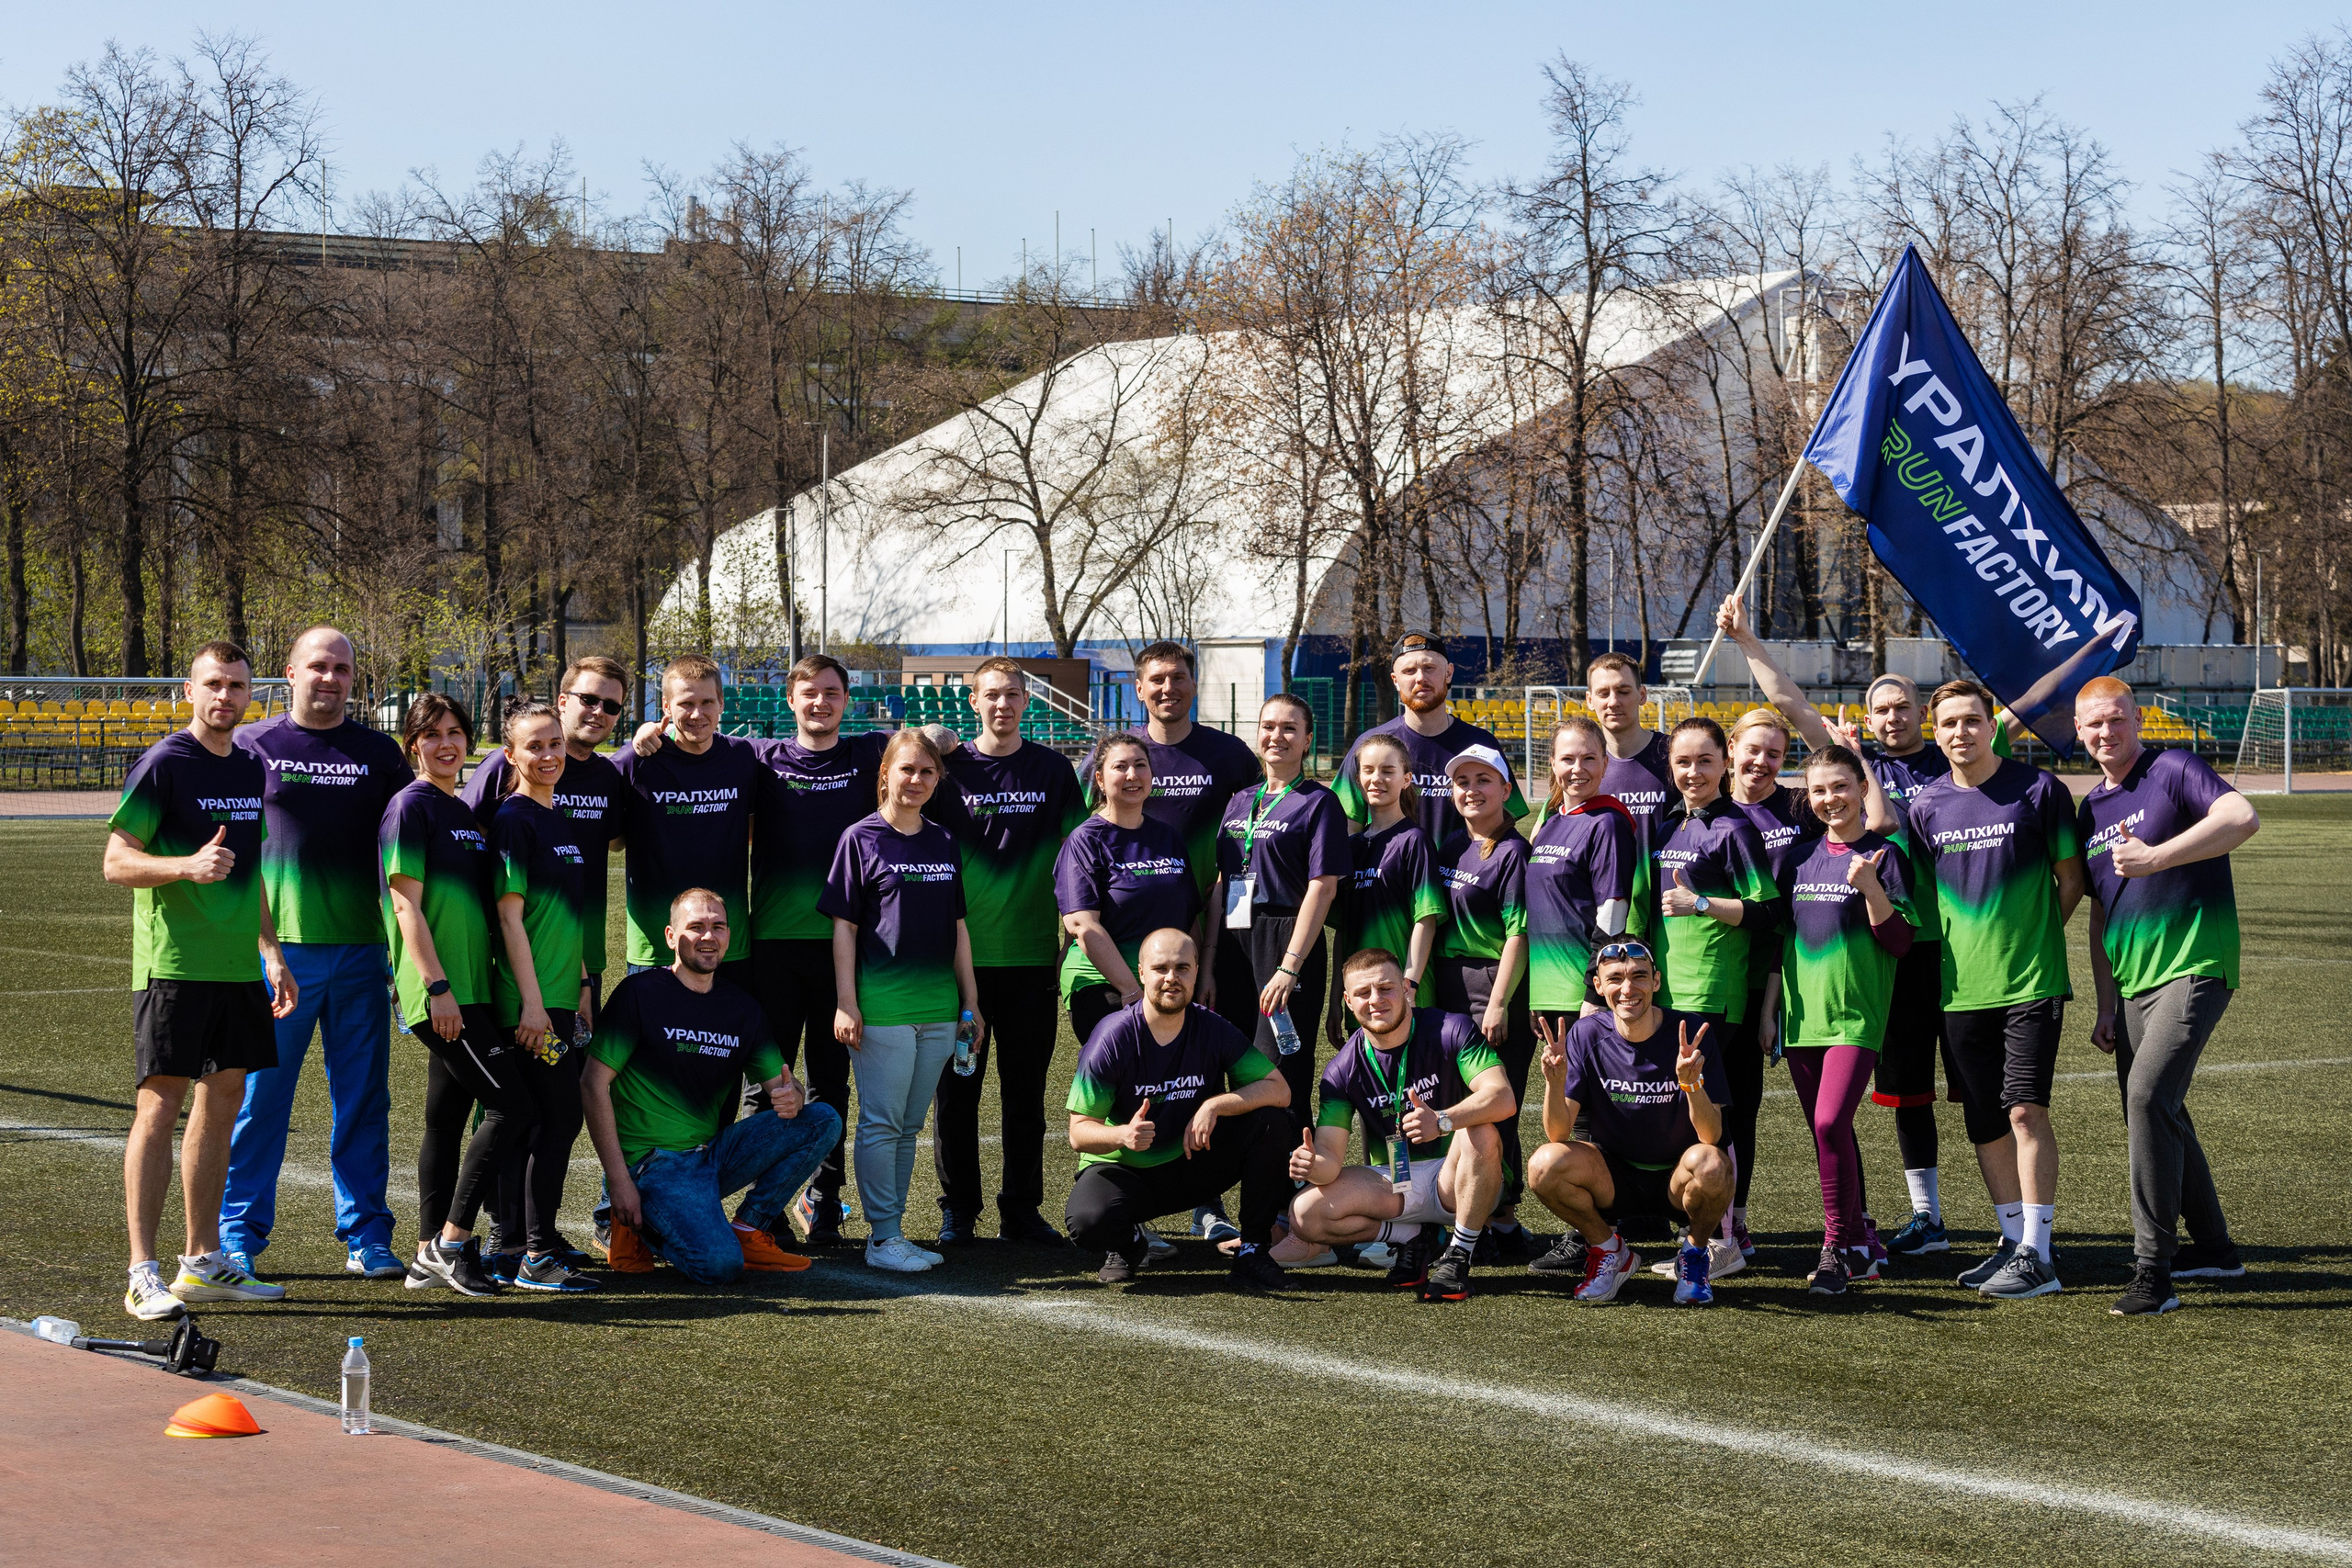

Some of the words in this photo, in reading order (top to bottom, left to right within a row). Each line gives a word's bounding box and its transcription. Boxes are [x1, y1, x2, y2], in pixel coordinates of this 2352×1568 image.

[1887, 331, 2138, 652] УРАЛХИМ
[267, 759, 368, 776] УРАЛХИМ
[1151, 774, 1213, 786] АЛХИМ
[552, 794, 608, 807] РАЛХИМ
[652, 787, 739, 804] УРАЛХИМ
[960, 792, 1046, 807] УРАЛХИМ
[197, 797, 263, 810] УРАЛХИМ
[1932, 822, 2015, 845] УРАЛХИМ
[1533, 845, 1571, 857] РАЛХИМ
[888, 863, 956, 873] УРАЛХИМ
[1114, 857, 1186, 870] УРАЛХИМ
[1439, 865, 1480, 886] РАЛХИМ
[1792, 884, 1859, 895] УРАЛХИМ
[663, 1027, 740, 1047] УРАЛХИМ
[1135, 1074, 1205, 1097] УРАЛХИМ
